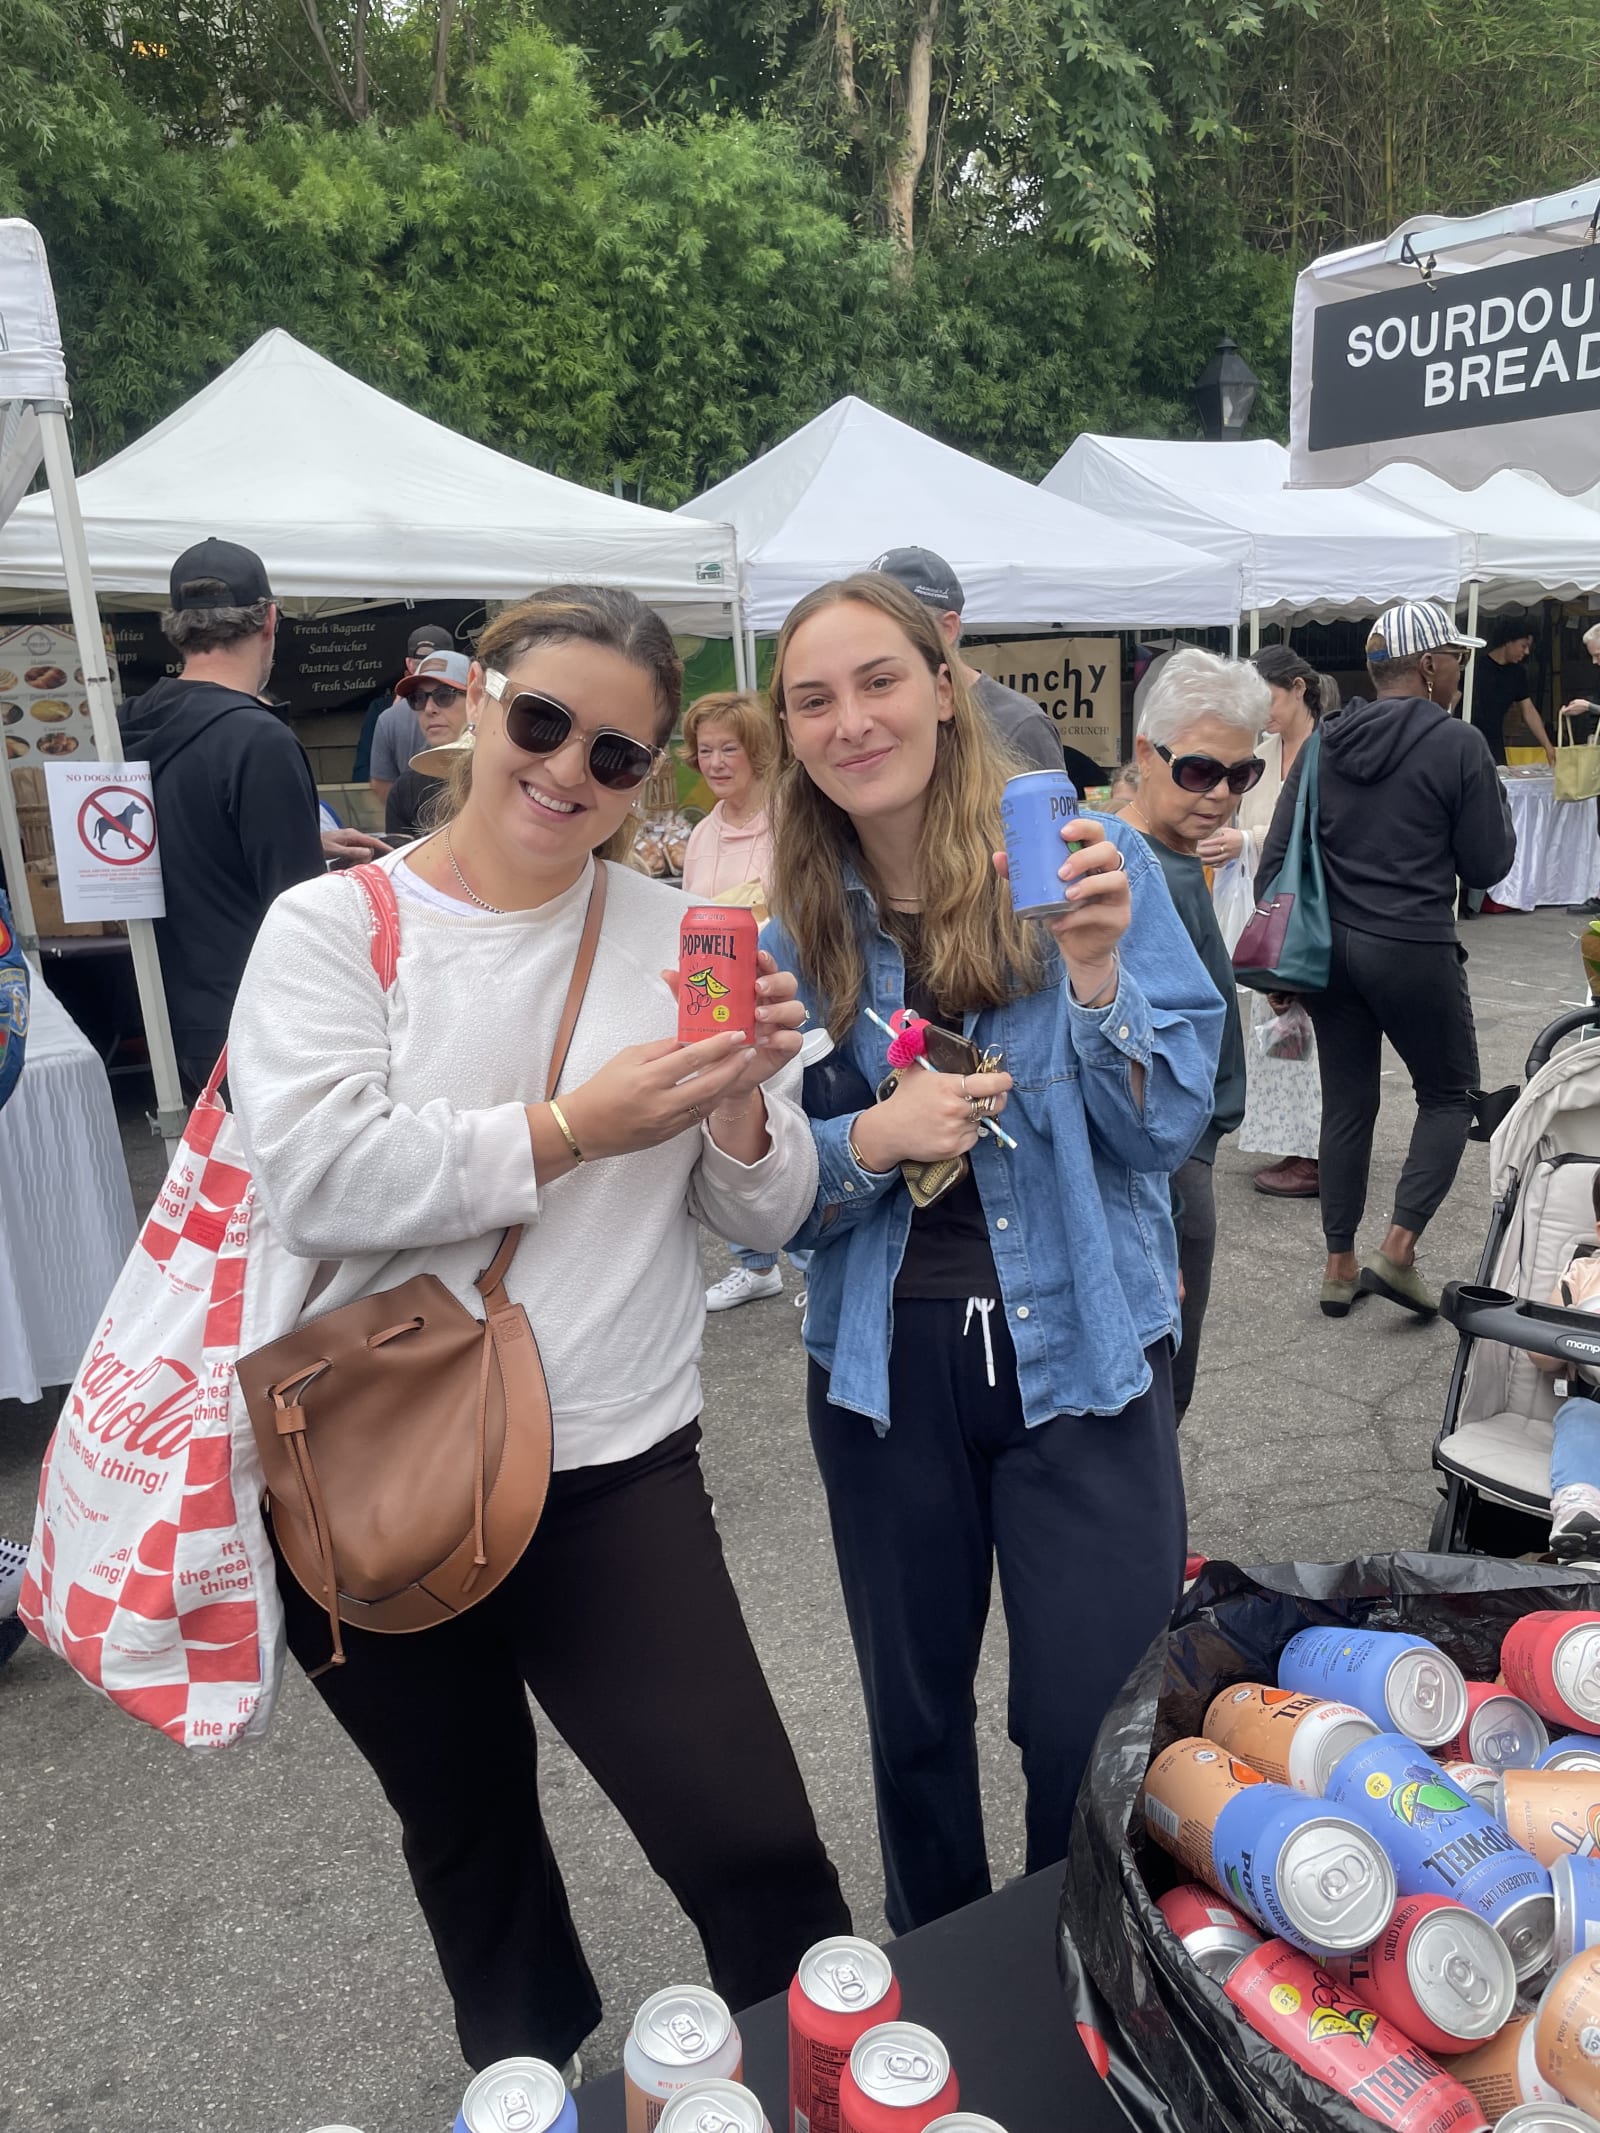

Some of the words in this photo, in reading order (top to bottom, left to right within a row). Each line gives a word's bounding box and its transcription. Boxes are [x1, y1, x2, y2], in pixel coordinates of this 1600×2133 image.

[1346, 278, 1595, 368] SOURDOU
[1424, 331, 1600, 407] BREAD
[293, 623, 329, 635] French
[330, 622, 376, 636] Baguette
[308, 641, 368, 655] Sandwiches
[118, 653, 137, 666] ups
[299, 662, 340, 674] Pastries
[355, 659, 383, 670] Tarts
[312, 682, 341, 693] Fresh
[342, 677, 377, 690] Salads
[66, 775, 82, 783] NO
[84, 774, 111, 783] DOGS
[682, 934, 737, 960] POPWELL
[166, 1179, 191, 1200] real
[1566, 1339, 1600, 1355] momp
[212, 1362, 236, 1378] it's
[68, 1427, 81, 1453] the
[81, 1445, 101, 1472] real
[101, 1457, 169, 1495] thing!
[221, 1540, 246, 1557] it's
[89, 1561, 126, 1585] ing!
[179, 1569, 211, 1587] the
[216, 1557, 251, 1577] real
[200, 1570, 254, 1596] thing!
[238, 1696, 260, 1714] it's
[193, 1719, 223, 1737] the
[1496, 1871, 1540, 1897] BLACKBERRY
[1261, 1874, 1292, 1932] BLACKBERRY
[1478, 1889, 1499, 1911] LIME
[1393, 1904, 1419, 1930] CHERRY
[1384, 1930, 1400, 1961] CITRUS
[811, 2044, 839, 2057] Nutrition
[811, 2061, 837, 2074] Calories
